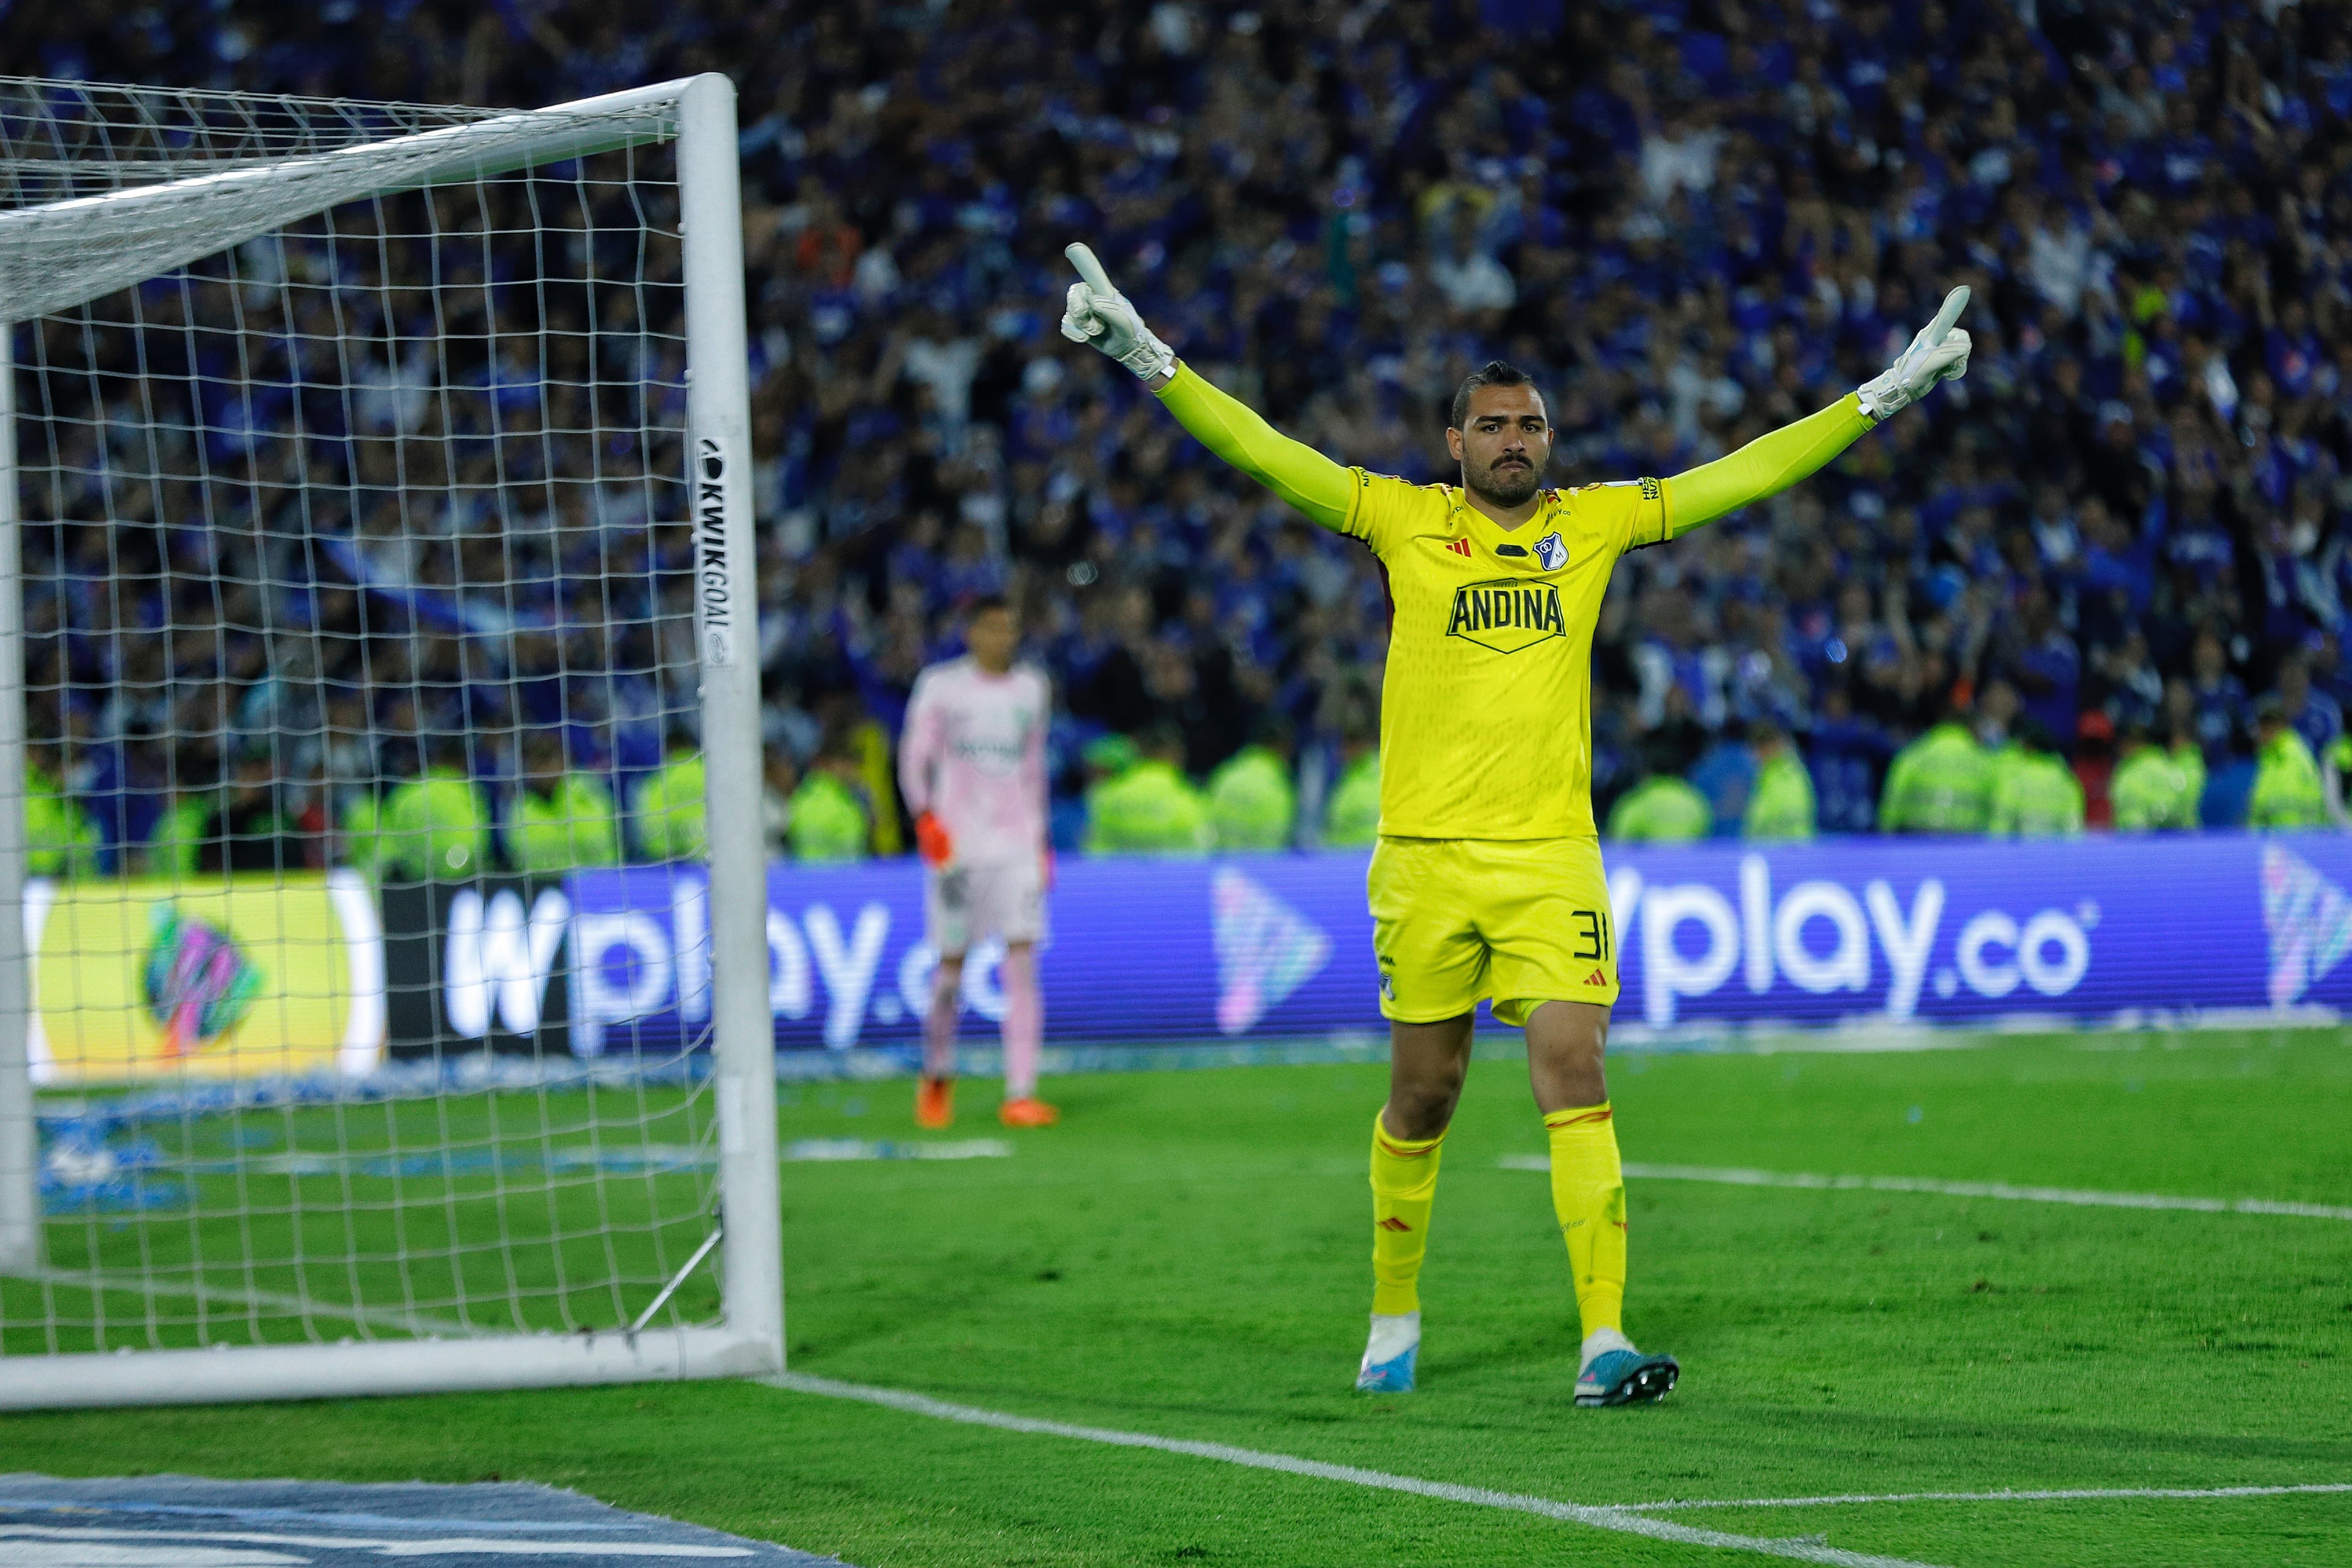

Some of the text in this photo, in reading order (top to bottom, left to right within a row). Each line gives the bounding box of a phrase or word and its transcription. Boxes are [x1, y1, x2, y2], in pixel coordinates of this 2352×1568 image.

[1451, 589, 1563, 633] ANDINA
[1571, 911, 1608, 962] 31
[1609, 853, 2090, 1029] play.co
